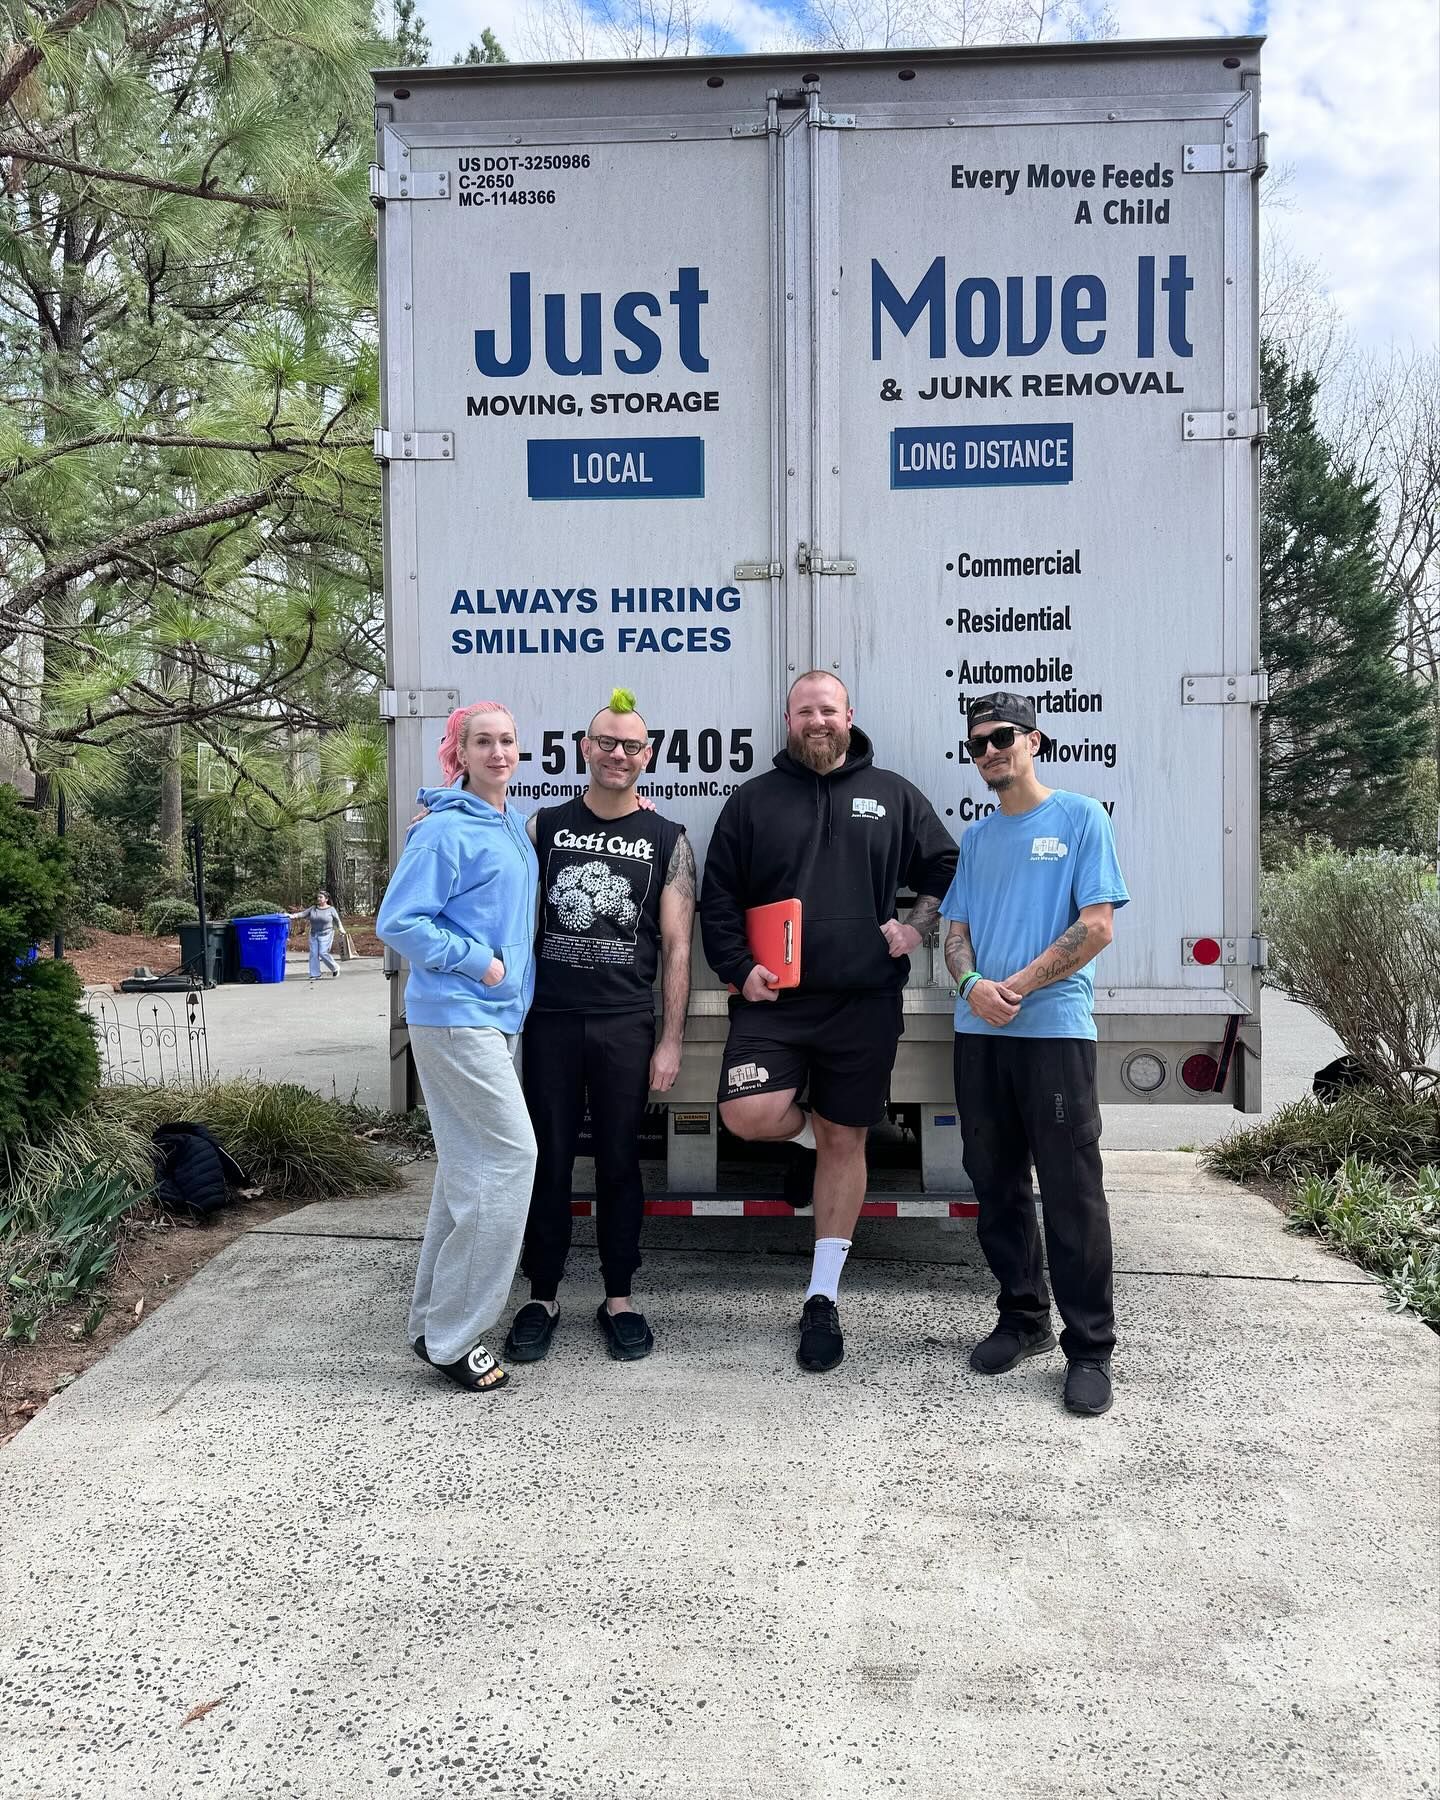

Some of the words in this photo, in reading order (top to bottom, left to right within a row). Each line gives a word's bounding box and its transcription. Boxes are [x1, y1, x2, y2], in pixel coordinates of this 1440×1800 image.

[458, 157, 481, 172] US
[483, 154, 591, 171] DOT-3250986
[458, 174, 514, 189] C-2650
[951, 164, 1019, 195] Every
[1027, 163, 1096, 189] Move
[1103, 162, 1174, 188] Feeds
[458, 190, 556, 207] MC-1148366
[1074, 200, 1092, 224] A
[1103, 199, 1170, 225] Child
[871, 255, 1107, 361] Move
[1137, 255, 1194, 359] It
[474, 267, 709, 378] Just
[880, 378, 903, 401] &
[918, 374, 1013, 401] JUNK
[1022, 371, 1184, 398] REMOVAL
[466, 393, 583, 417] MOVING,
[590, 391, 720, 414] STORAGE
[572, 452, 653, 484] LOCAL
[899, 441, 957, 472] LONG
[964, 438, 1068, 469] DISTANCE
[957, 549, 1082, 578] Commercial
[449, 588, 598, 614] ALWAYS
[611, 586, 741, 613] HIRING
[957, 605, 1072, 633] Residential
[451, 627, 605, 654] SMILING
[617, 626, 732, 653] FACES
[957, 657, 1073, 685] Automobile
[553, 829, 606, 852] Cacti
[606, 836, 655, 860] Cult
